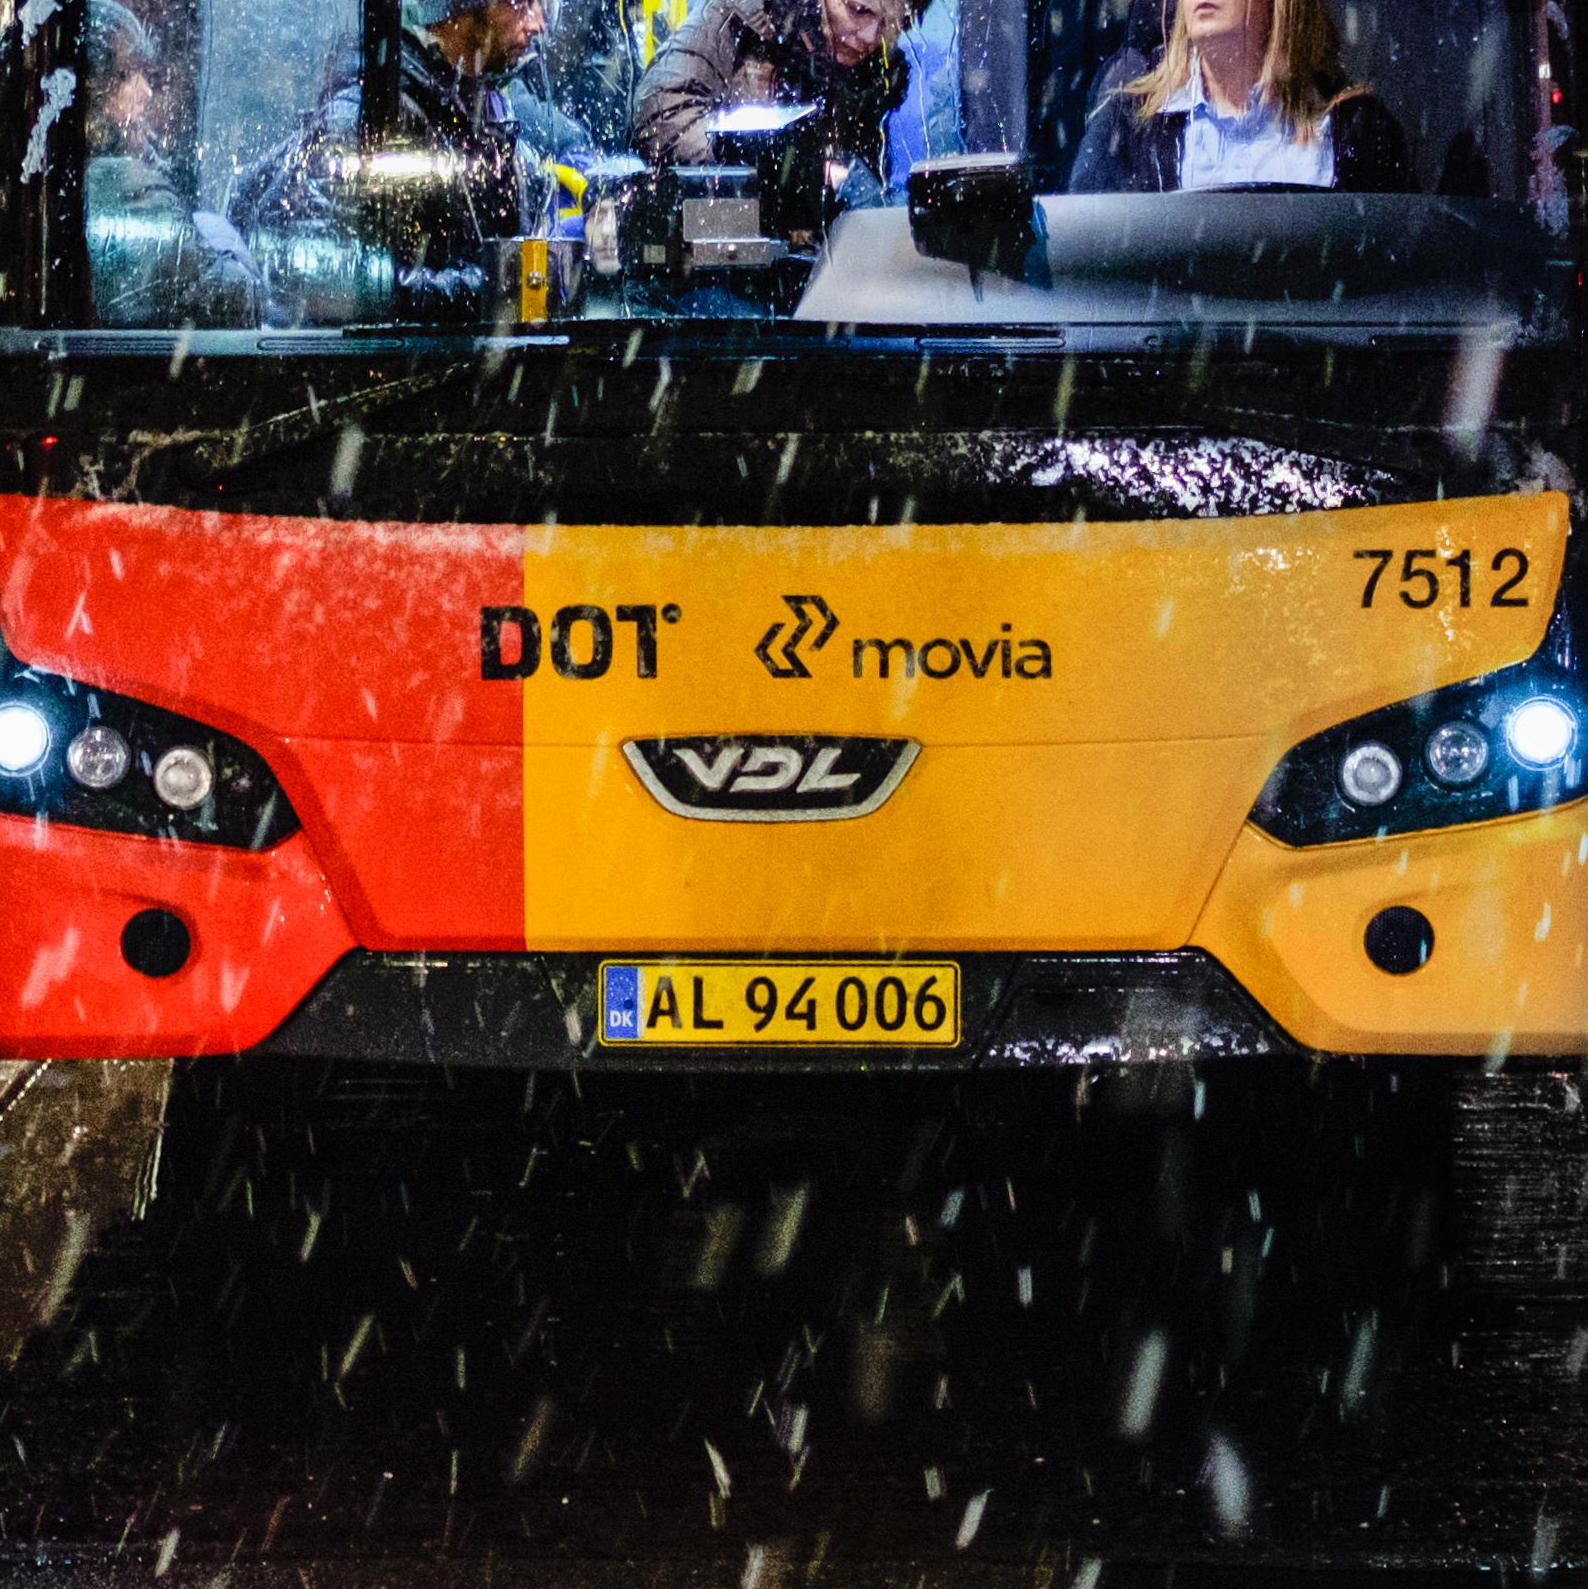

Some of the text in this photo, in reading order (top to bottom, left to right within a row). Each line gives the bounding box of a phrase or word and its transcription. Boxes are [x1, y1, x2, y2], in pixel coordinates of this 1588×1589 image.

[1353, 548, 1529, 609] 7512
[480, 604, 1053, 680] DOT movia
[673, 746, 862, 793] VDL
[609, 976, 948, 1033] DK AL 94 006
